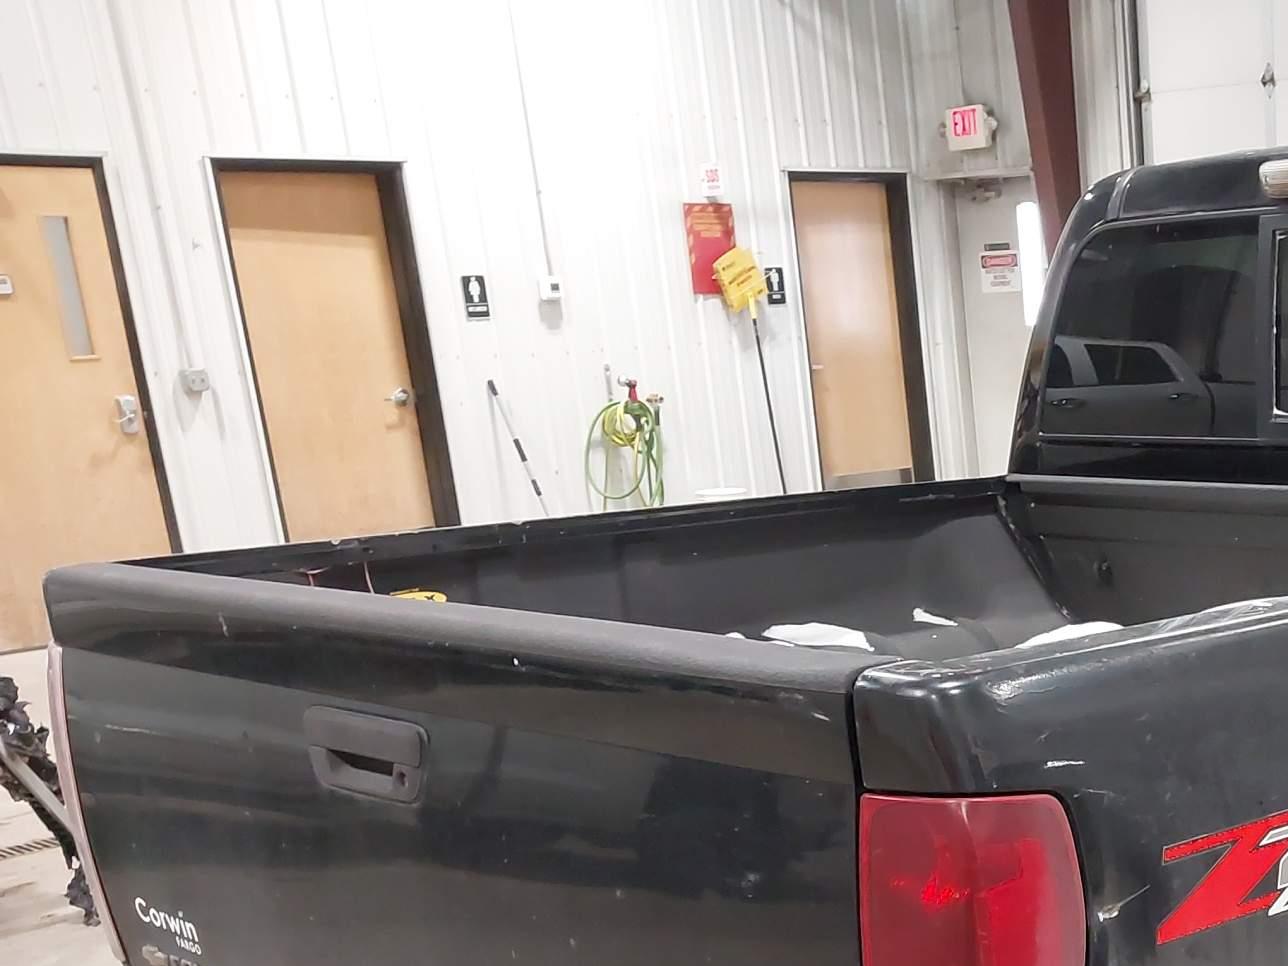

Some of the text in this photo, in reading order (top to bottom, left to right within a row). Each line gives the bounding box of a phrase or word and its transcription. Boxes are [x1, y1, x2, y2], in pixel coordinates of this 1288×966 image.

[952, 108, 977, 136] EXIT
[134, 896, 199, 942] Corwin
[175, 937, 202, 956] FARGO
